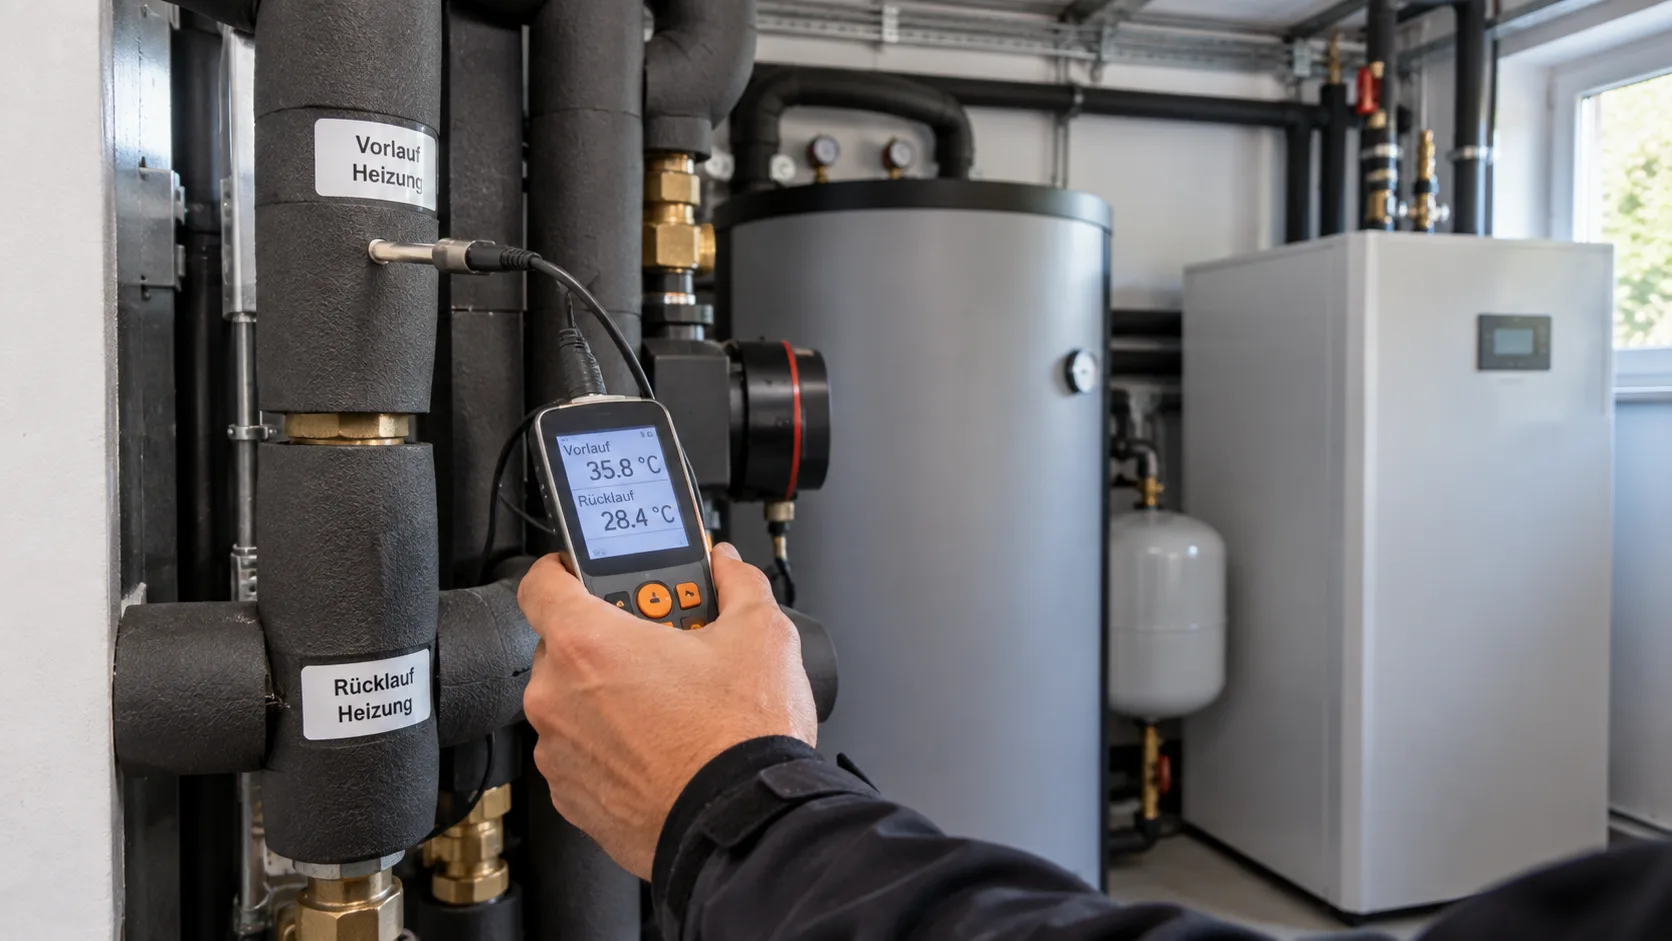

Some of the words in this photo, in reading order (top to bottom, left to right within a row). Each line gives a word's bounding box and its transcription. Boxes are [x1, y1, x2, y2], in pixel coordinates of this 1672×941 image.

[355, 135, 421, 163] Vorlauf
[353, 163, 423, 194] Heizung
[563, 441, 611, 456] Vorlauf
[586, 458, 634, 481] 35.8
[638, 455, 661, 474] °C
[578, 490, 635, 507] Rücklauf
[601, 507, 649, 531] 28.4
[652, 505, 675, 523] °C
[334, 667, 415, 696] Rücklauf
[338, 697, 413, 723] Heizung
